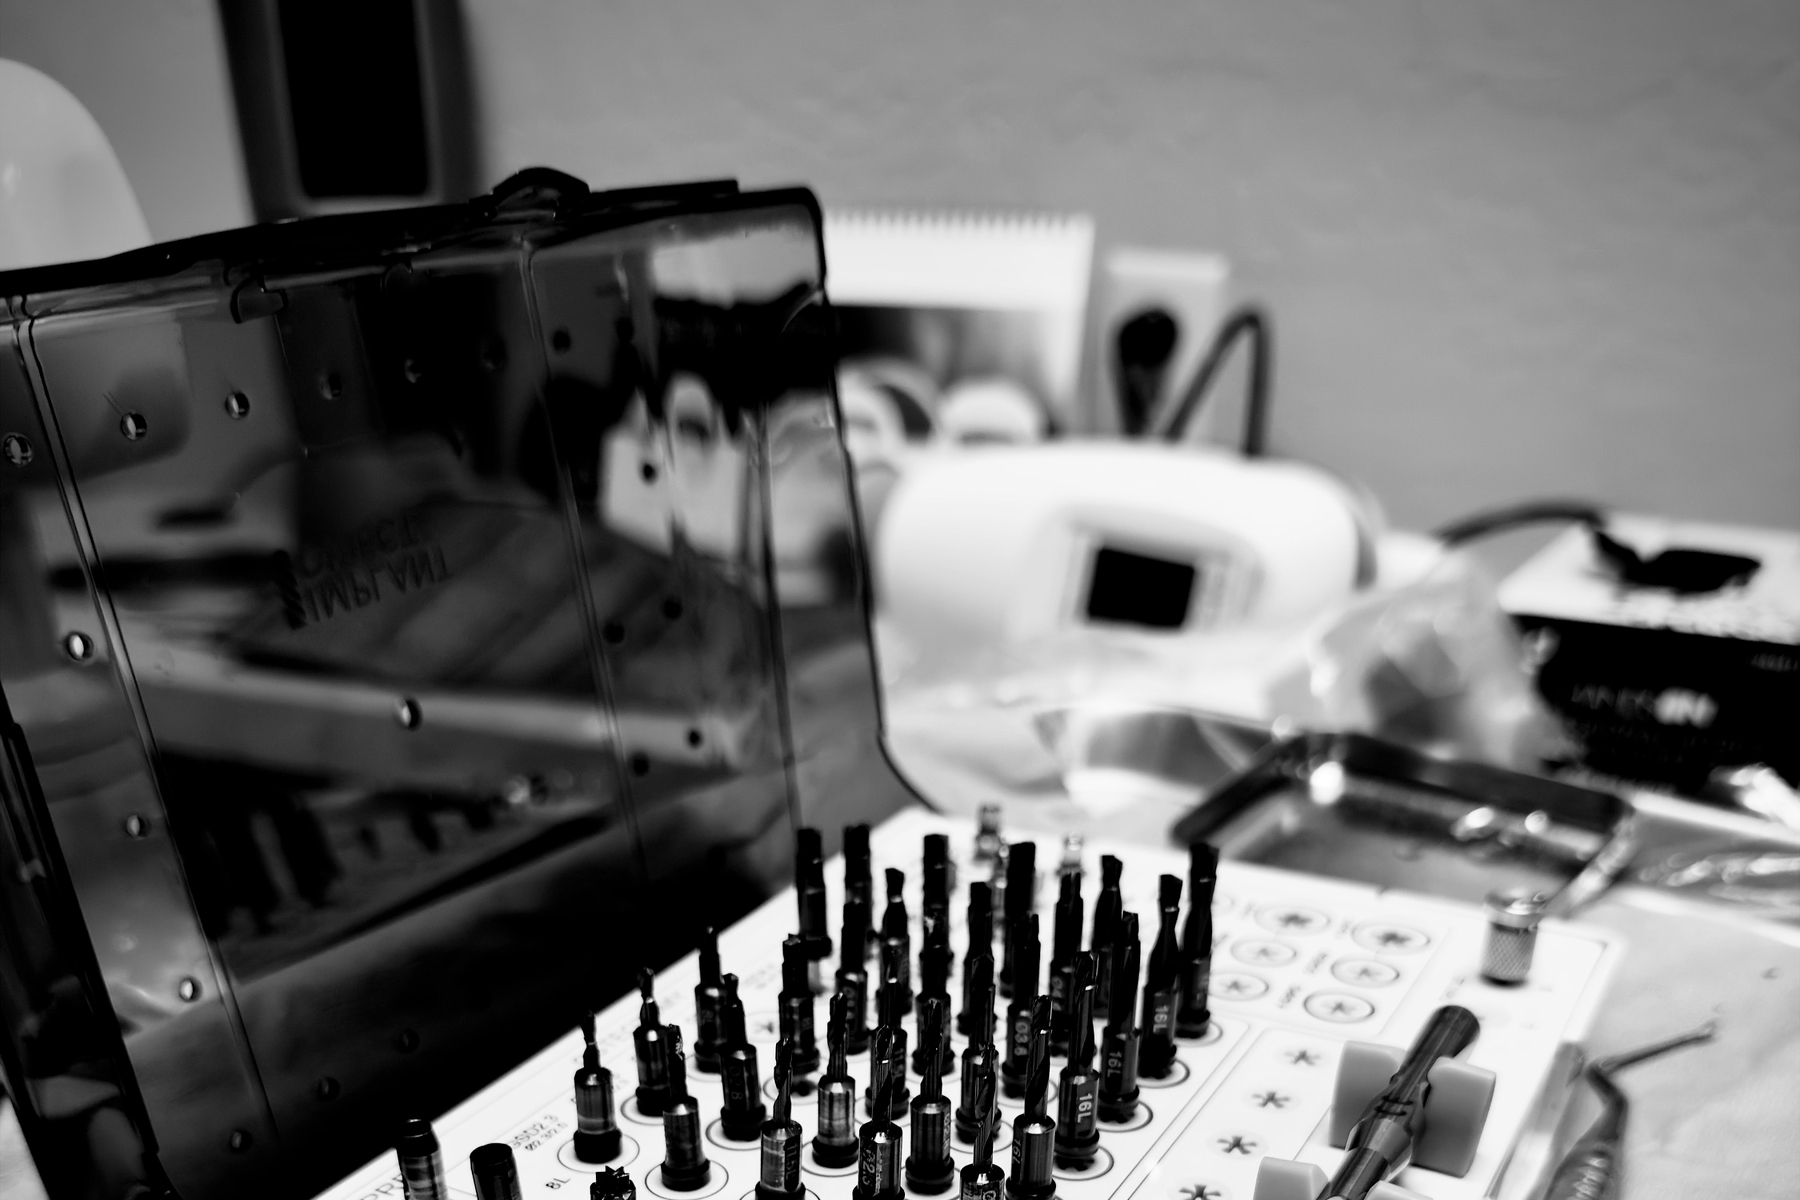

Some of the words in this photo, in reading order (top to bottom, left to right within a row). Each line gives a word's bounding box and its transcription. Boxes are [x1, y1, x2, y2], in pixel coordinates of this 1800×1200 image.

[1153, 1004, 1169, 1034] 16L
[1107, 1051, 1122, 1078] 16L
[1077, 1092, 1093, 1123] 16L
[785, 1141, 799, 1181] 11.5L
[1012, 1138, 1022, 1164] 16L
